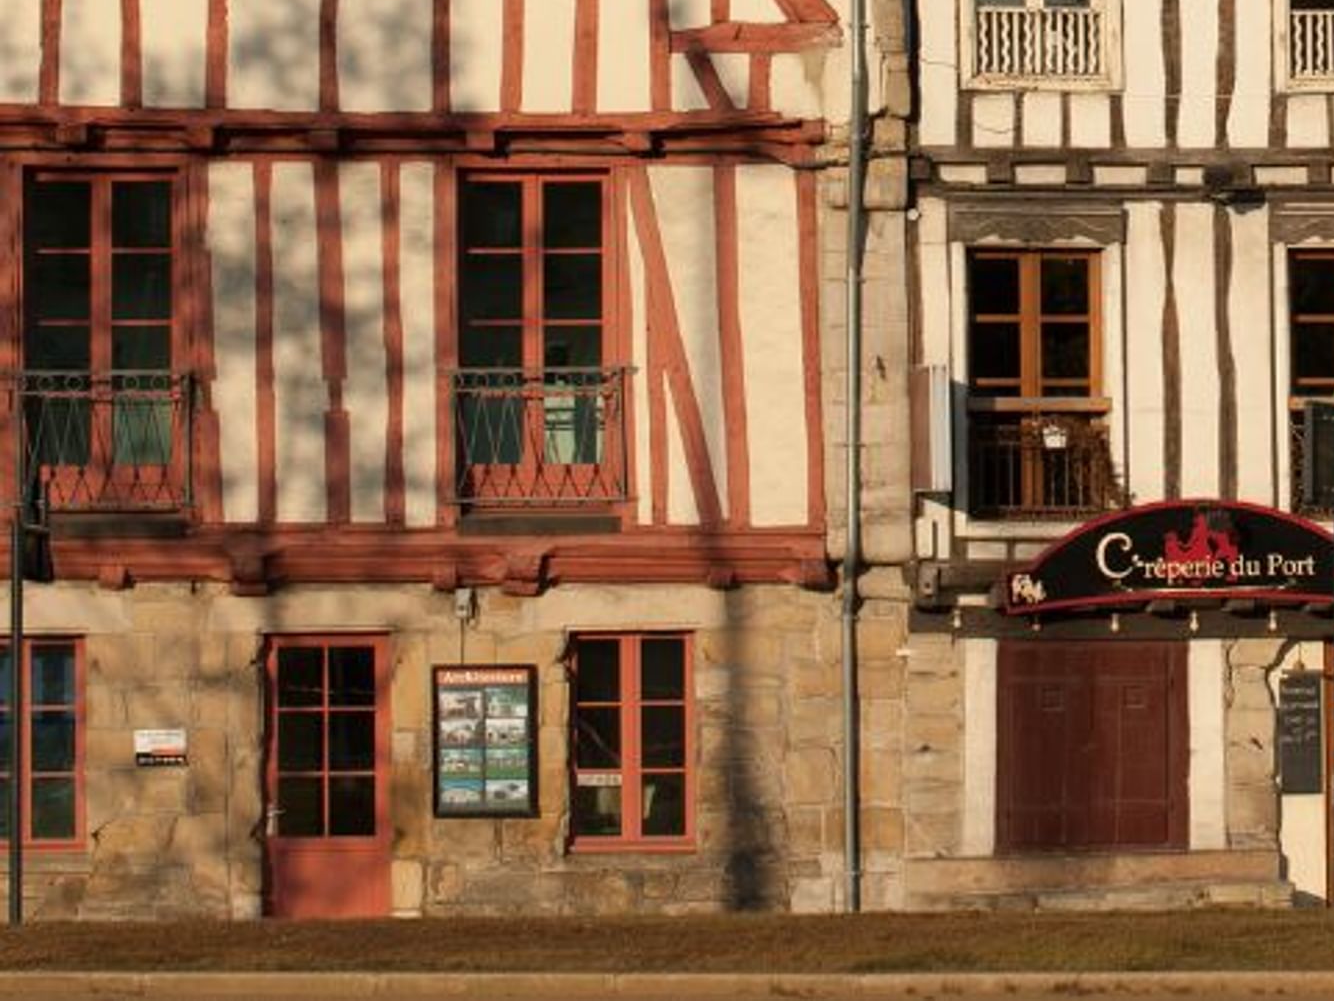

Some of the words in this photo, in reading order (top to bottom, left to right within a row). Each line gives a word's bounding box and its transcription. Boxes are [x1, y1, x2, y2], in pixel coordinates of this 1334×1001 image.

[1095, 532, 1225, 587] Crêperie
[1231, 555, 1261, 577] du
[1267, 554, 1315, 577] Port
